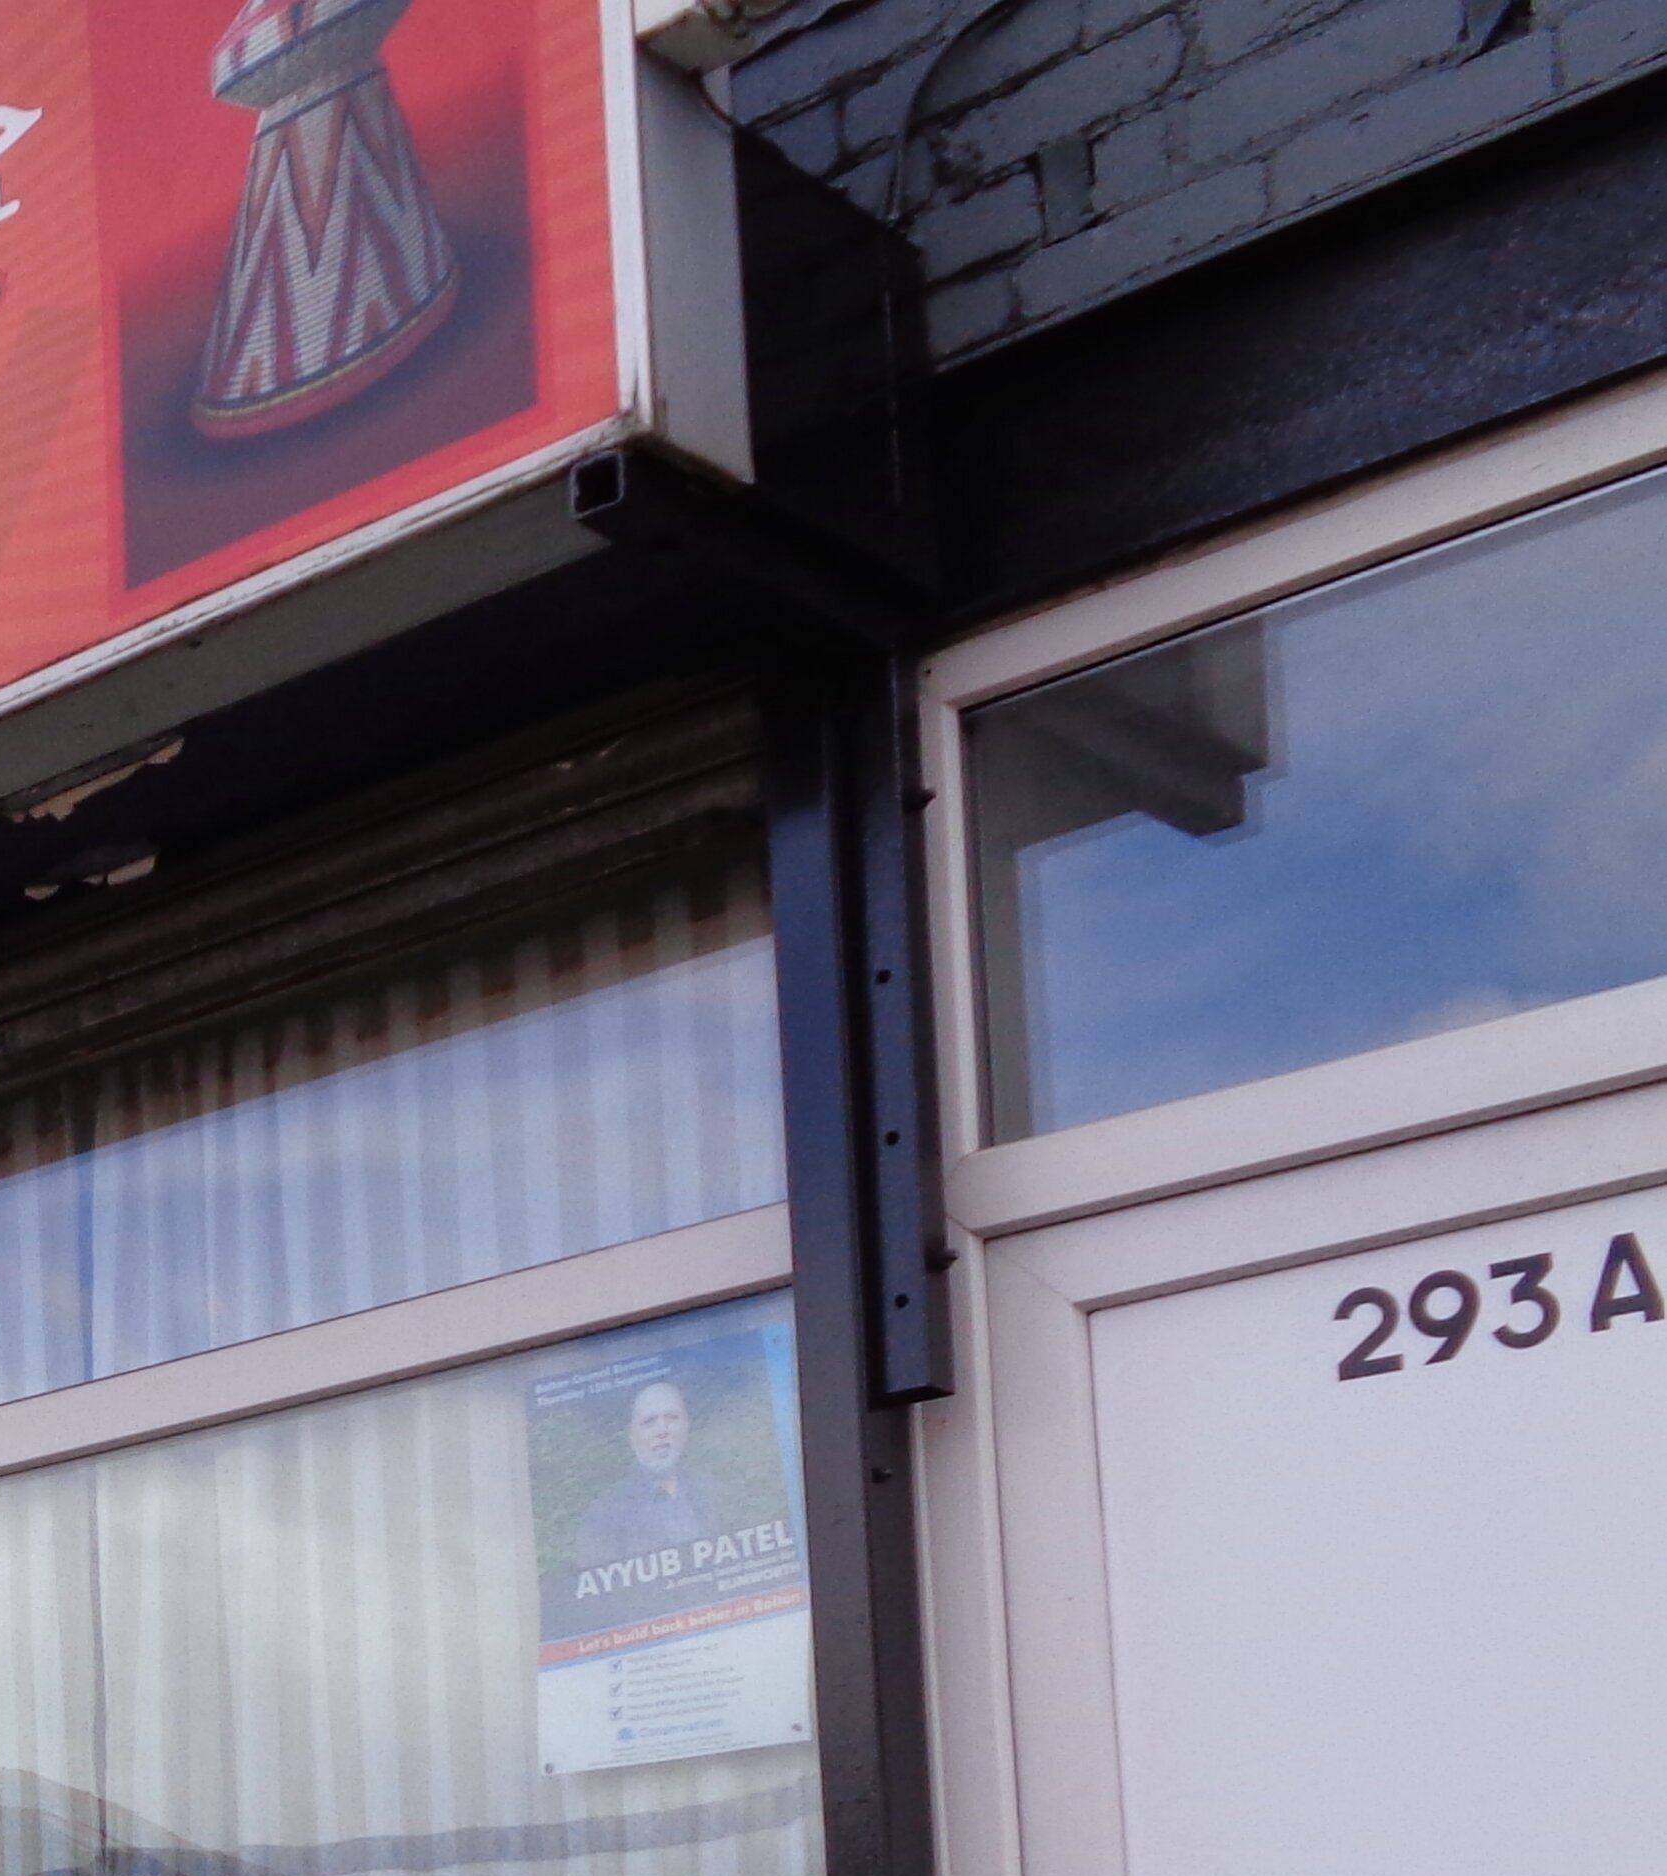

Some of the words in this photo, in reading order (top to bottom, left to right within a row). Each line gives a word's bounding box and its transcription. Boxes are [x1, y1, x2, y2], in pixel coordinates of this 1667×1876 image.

[576, 1548, 682, 1599] AYYUB
[693, 1520, 794, 1569] PATEL
[579, 1635, 611, 1653] Let's
[615, 1626, 648, 1645] build
[652, 1618, 685, 1636] back
[689, 1607, 733, 1627] better
[754, 1591, 801, 1613] Bolton
